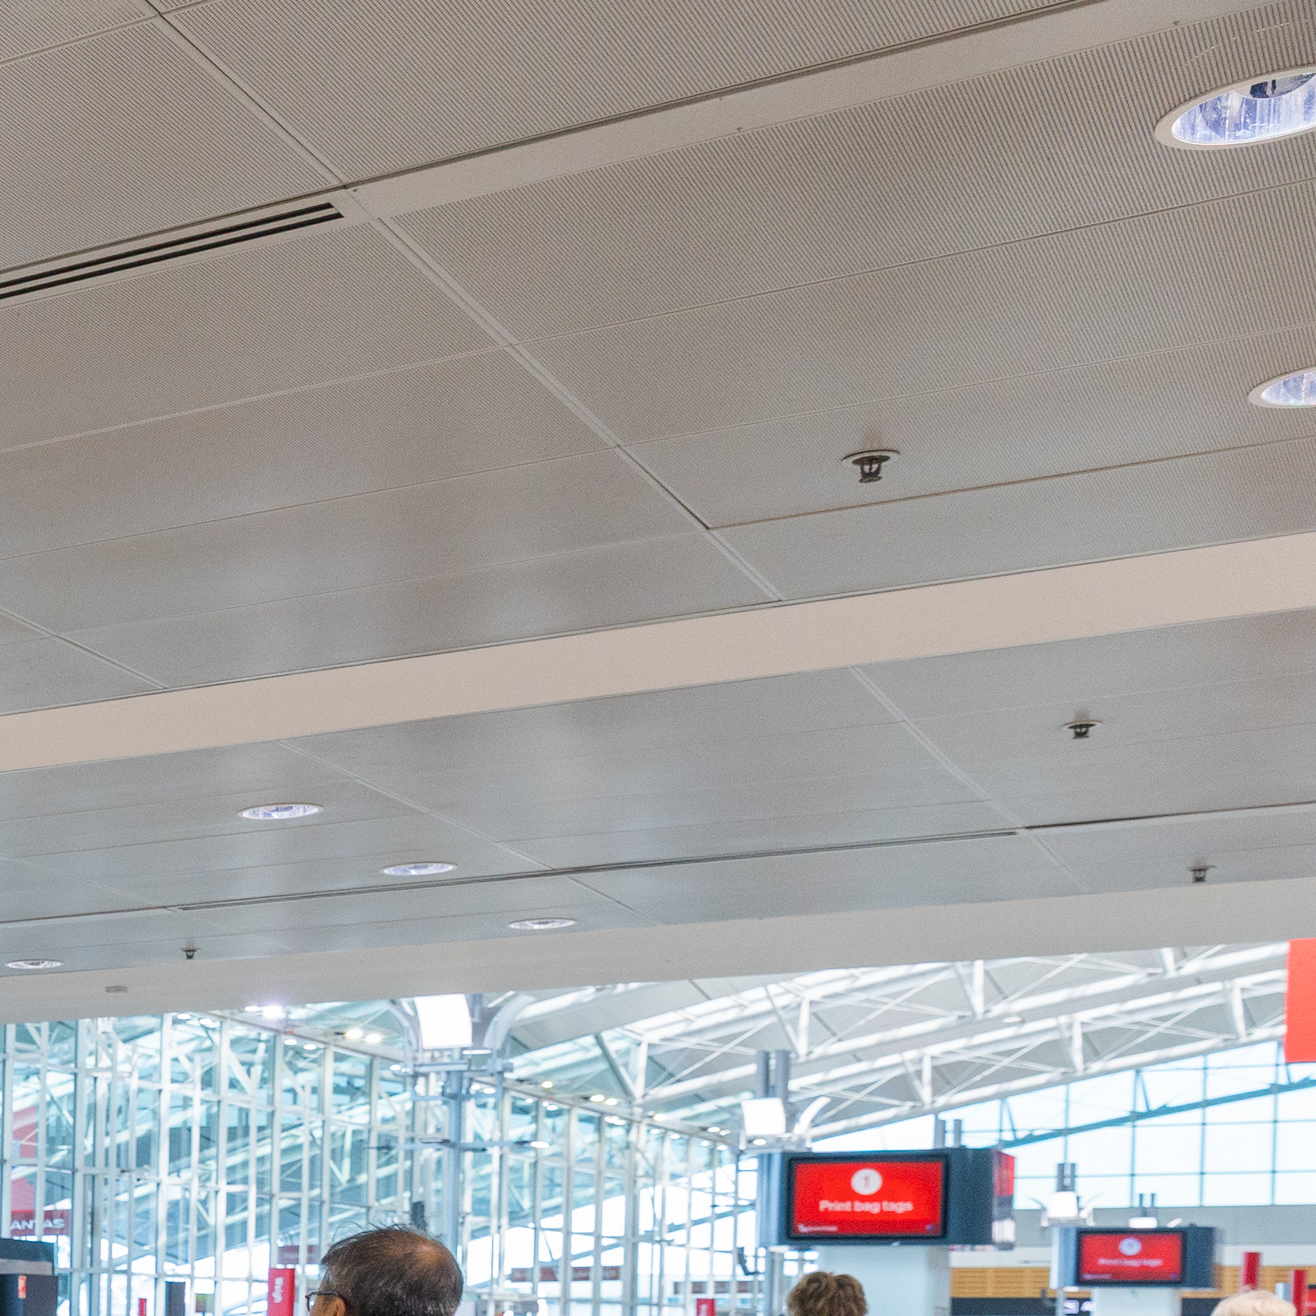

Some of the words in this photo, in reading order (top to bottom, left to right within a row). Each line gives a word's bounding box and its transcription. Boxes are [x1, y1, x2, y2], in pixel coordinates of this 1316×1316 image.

[819, 1200, 852, 1212] Print
[854, 1200, 880, 1214] bag
[882, 1201, 913, 1214] tags
